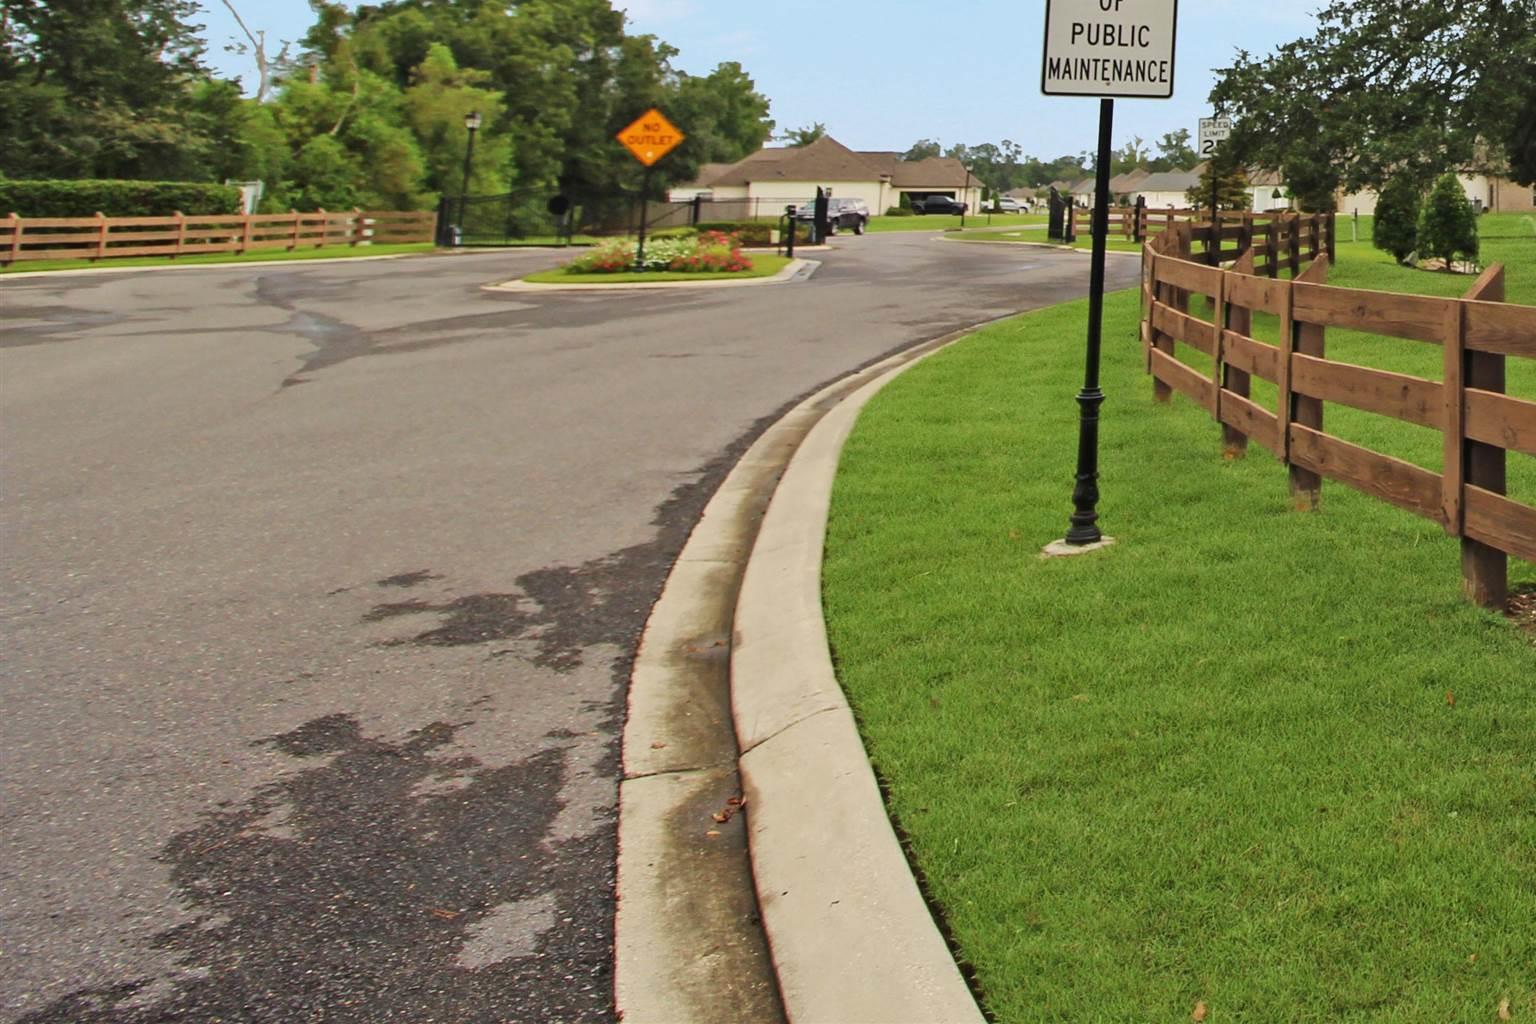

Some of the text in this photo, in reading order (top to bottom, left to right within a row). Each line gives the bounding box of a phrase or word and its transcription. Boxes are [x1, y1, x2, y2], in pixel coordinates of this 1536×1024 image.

[1071, 23, 1150, 47] PUBLIC
[1048, 57, 1168, 83] MAINTENANCE
[642, 122, 660, 132] NO
[1201, 121, 1229, 129] SPEED
[627, 135, 673, 146] OUTLET
